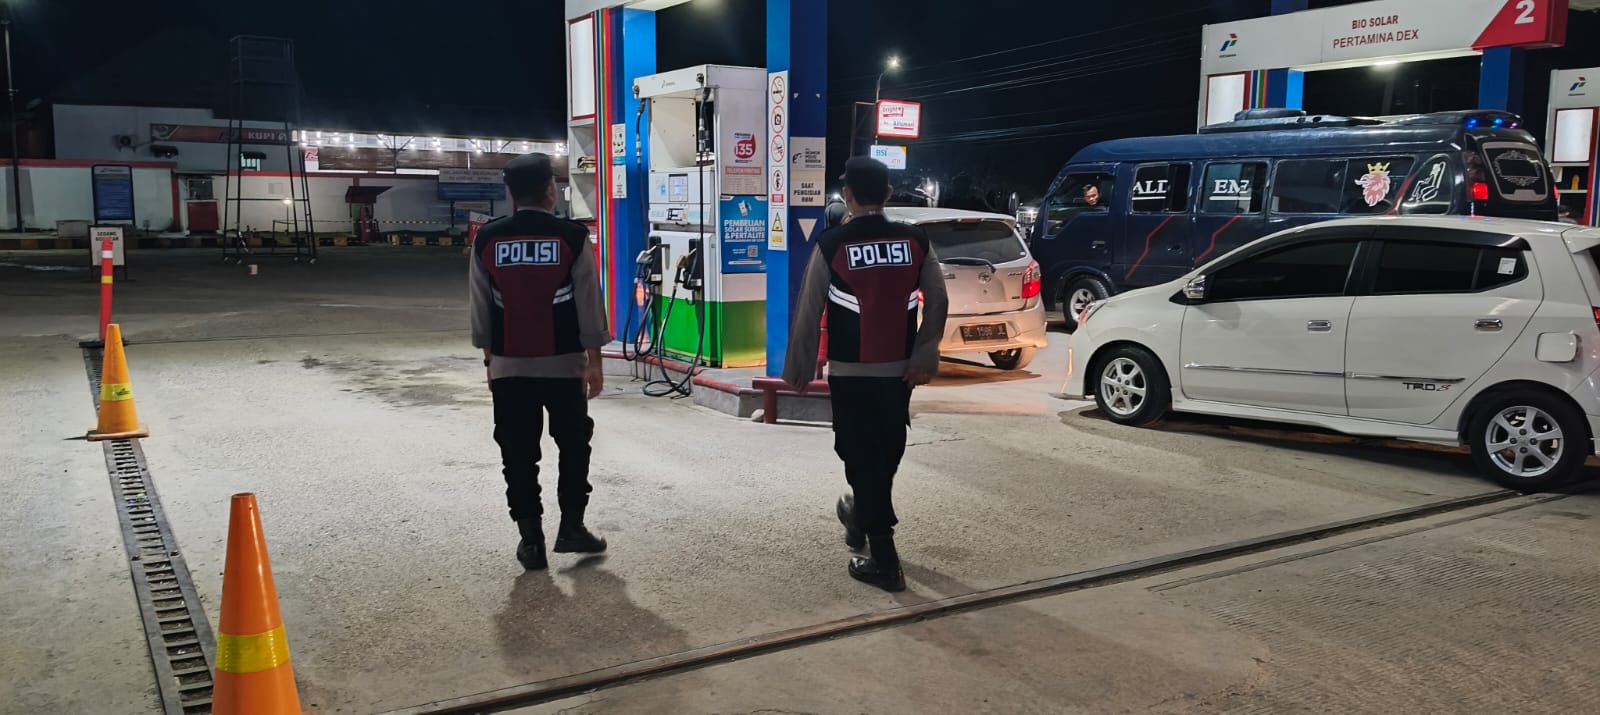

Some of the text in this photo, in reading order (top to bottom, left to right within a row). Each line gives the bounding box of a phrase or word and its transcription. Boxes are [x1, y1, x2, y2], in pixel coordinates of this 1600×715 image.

[1513, 0, 1535, 25] 2
[1352, 14, 1399, 30] BIO SOLAR
[1333, 28, 1420, 49] PERTAMINA DEX
[735, 143, 753, 156] 135
[724, 219, 765, 227] PEMBELIAN
[498, 242, 557, 264] POLISI
[848, 242, 910, 267] POLISI
[1402, 382, 1435, 392] TRD
